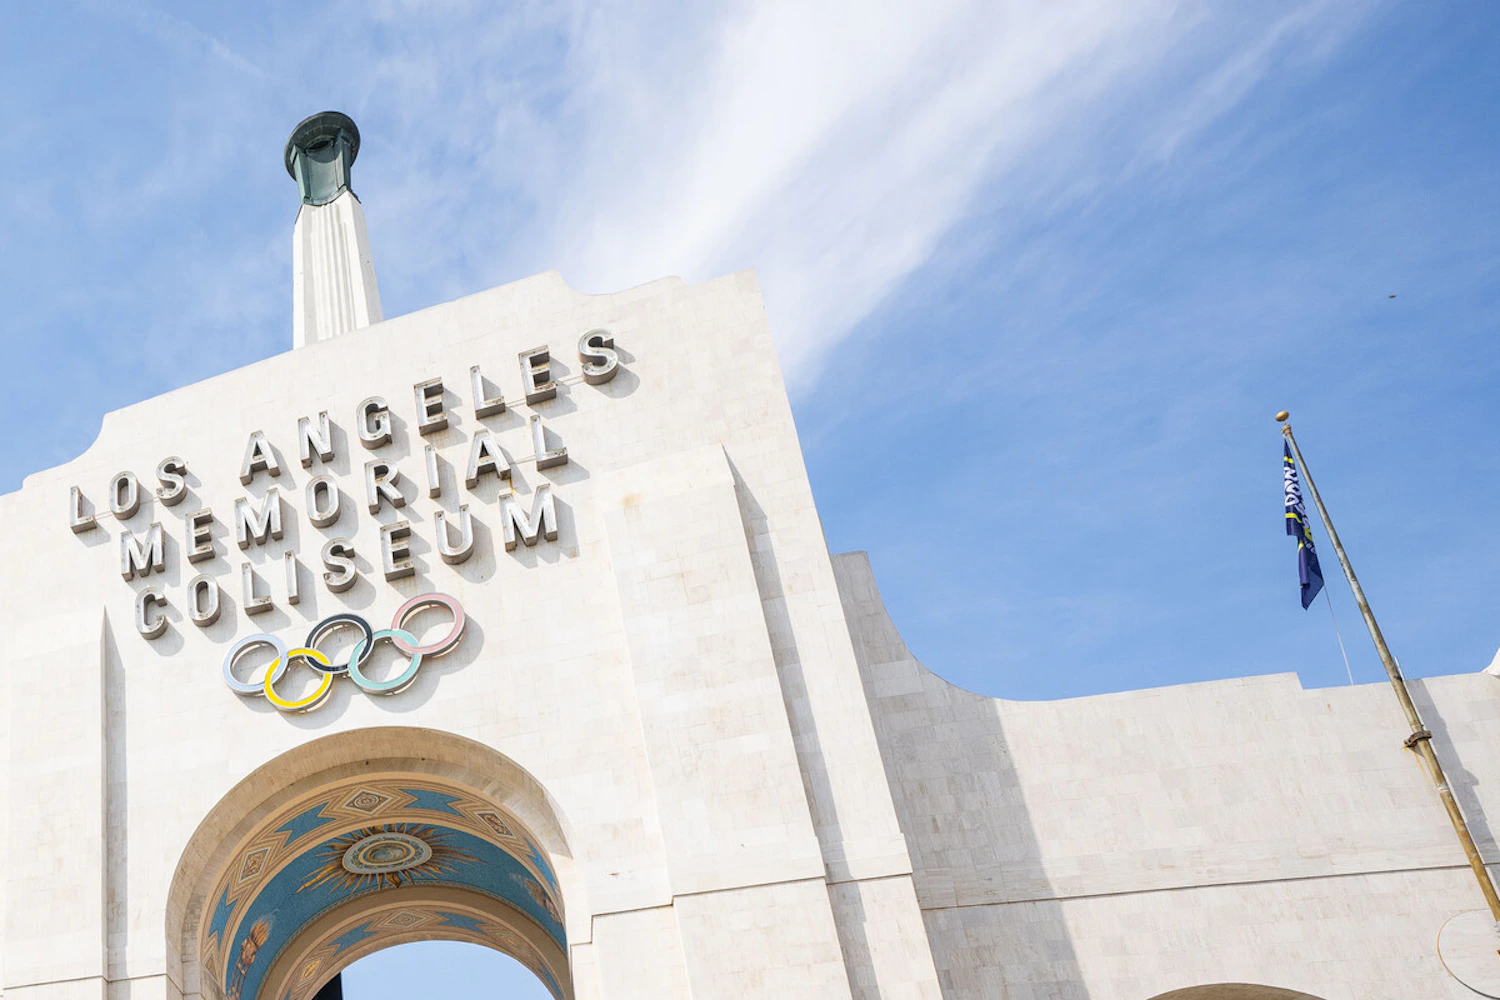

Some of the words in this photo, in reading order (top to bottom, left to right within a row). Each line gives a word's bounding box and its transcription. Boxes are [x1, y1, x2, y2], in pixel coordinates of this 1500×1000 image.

[70, 456, 187, 534] LOS
[240, 328, 619, 485] ANGELES
[121, 415, 568, 582] MEMORIAL
[136, 483, 558, 640] COLISEUM
